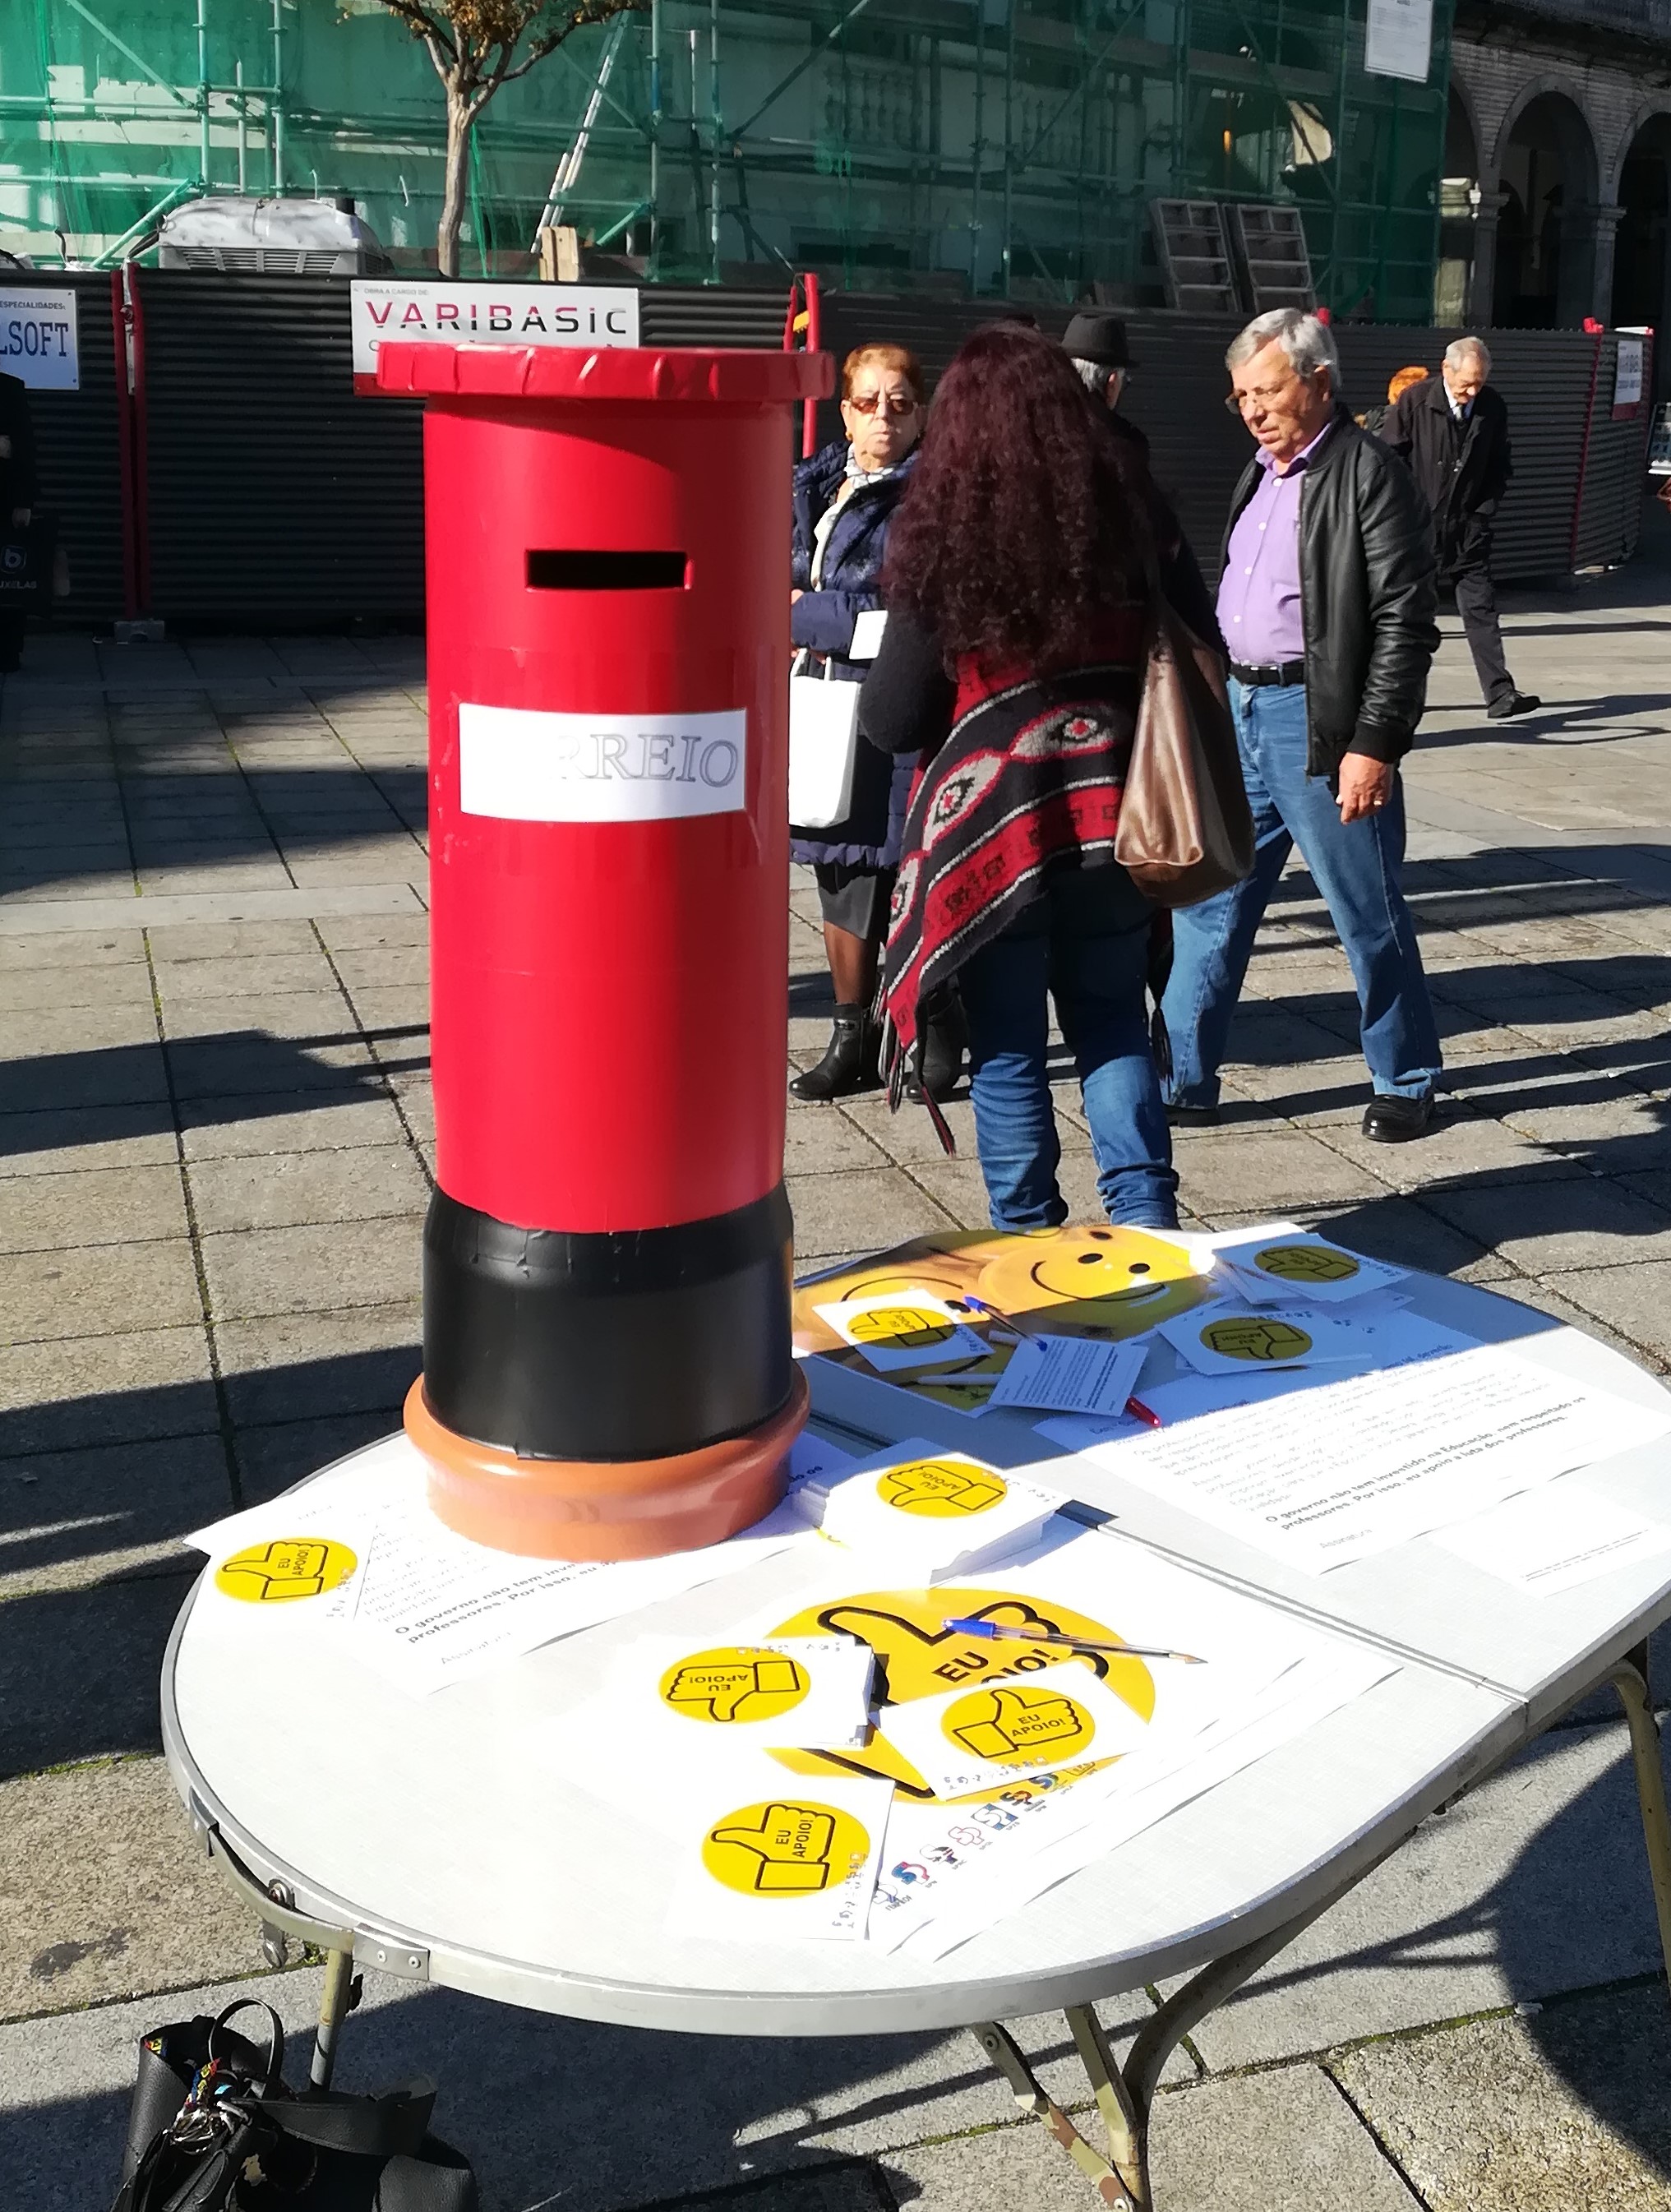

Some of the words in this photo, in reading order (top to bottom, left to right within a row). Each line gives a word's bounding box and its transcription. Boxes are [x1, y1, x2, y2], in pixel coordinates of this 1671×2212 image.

[1281, 1498, 1328, 1519] governo
[1330, 1489, 1351, 1500] não
[1351, 1480, 1376, 1491] tem
[1373, 1457, 1426, 1481] investido
[1498, 1422, 1519, 1433] nem
[1353, 1490, 1375, 1502] Por
[1422, 1458, 1452, 1472] apoio
[415, 1598, 478, 1628] governo
[482, 1586, 510, 1600] não
[513, 1575, 542, 1587] tem
[507, 1588, 535, 1600] Por
[931, 1651, 989, 1683] EU
[689, 1674, 749, 1684] APOIO!
[708, 1683, 731, 1692] EU
[1011, 1718, 1068, 1737] APOIO!
[1018, 1714, 1041, 1725] EU
[775, 1830, 792, 1845] EU
[792, 1819, 814, 1858] APOIO!
